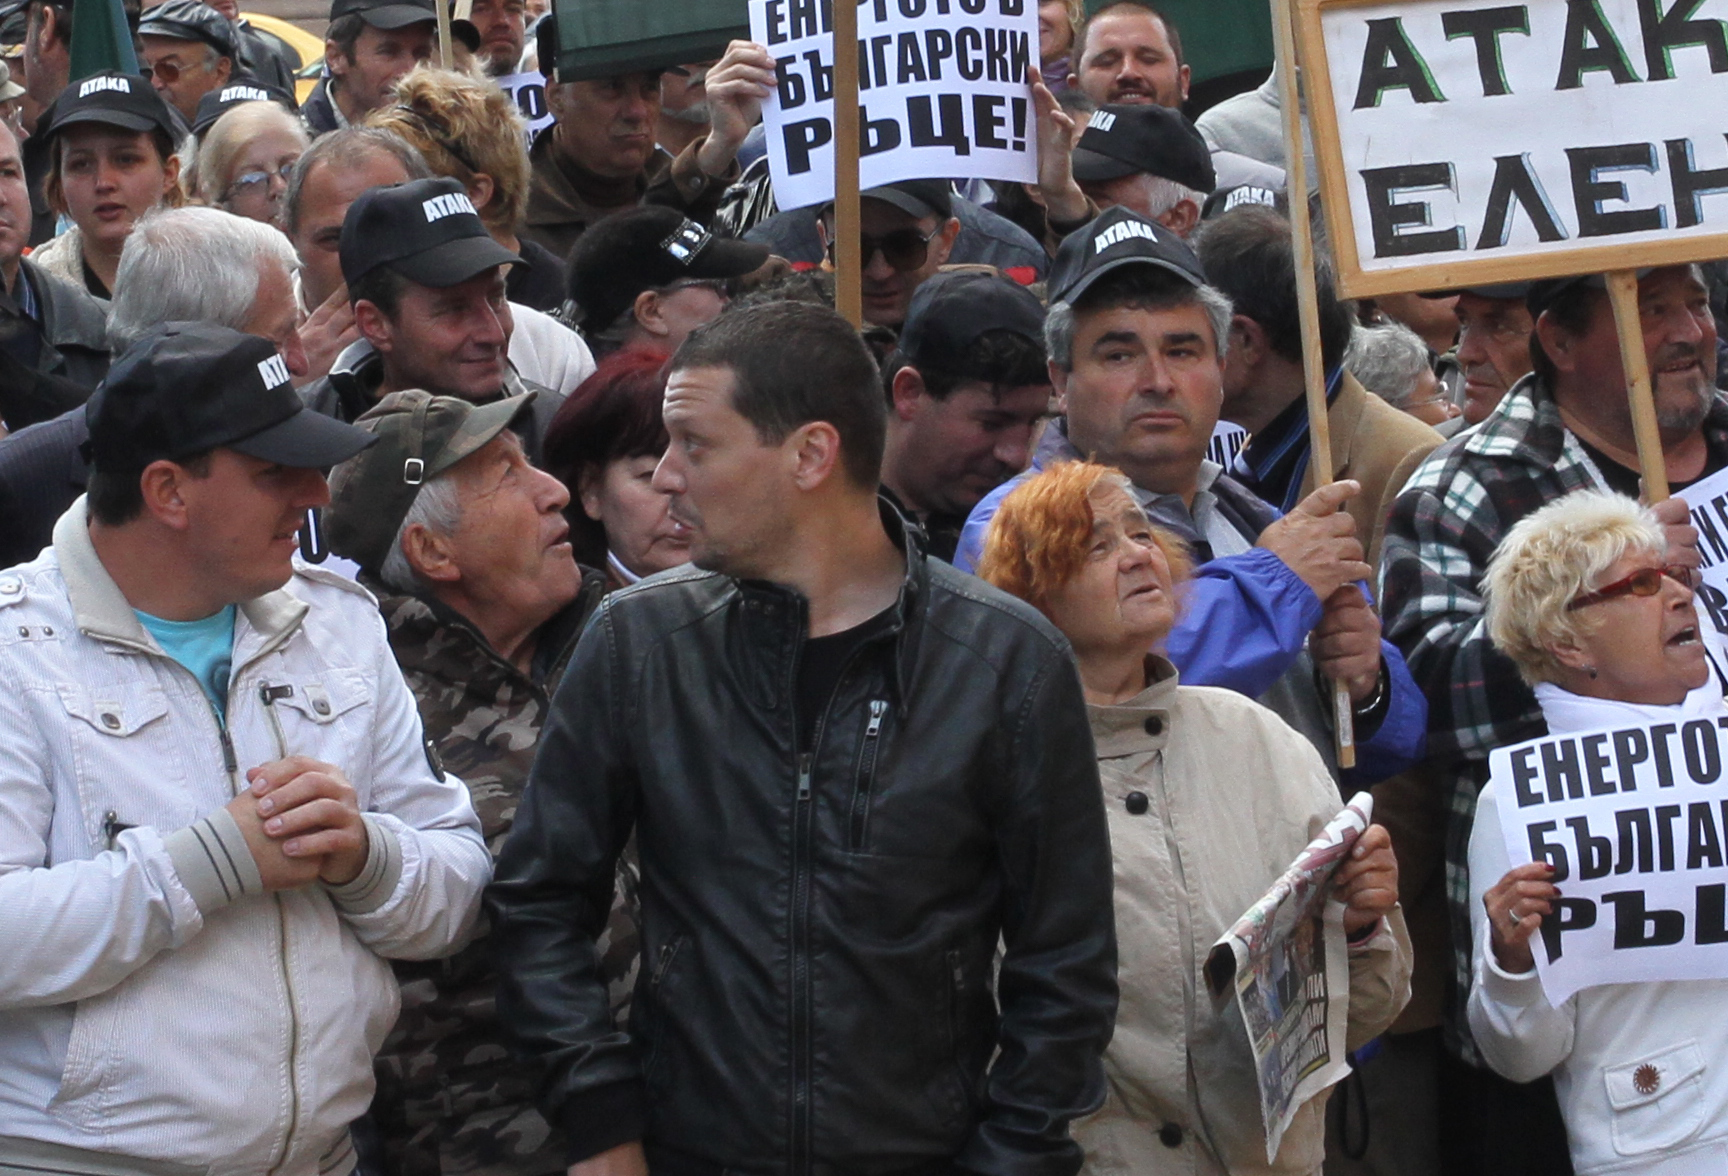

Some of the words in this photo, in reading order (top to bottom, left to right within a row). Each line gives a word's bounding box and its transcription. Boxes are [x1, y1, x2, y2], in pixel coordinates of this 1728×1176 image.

[79, 76, 130, 98] АТАКА
[220, 86, 268, 103] АТАКА
[782, 93, 1028, 176] РЪЦЕ!
[1224, 186, 1275, 212] АТАКА
[1094, 220, 1158, 255] АТАКА
